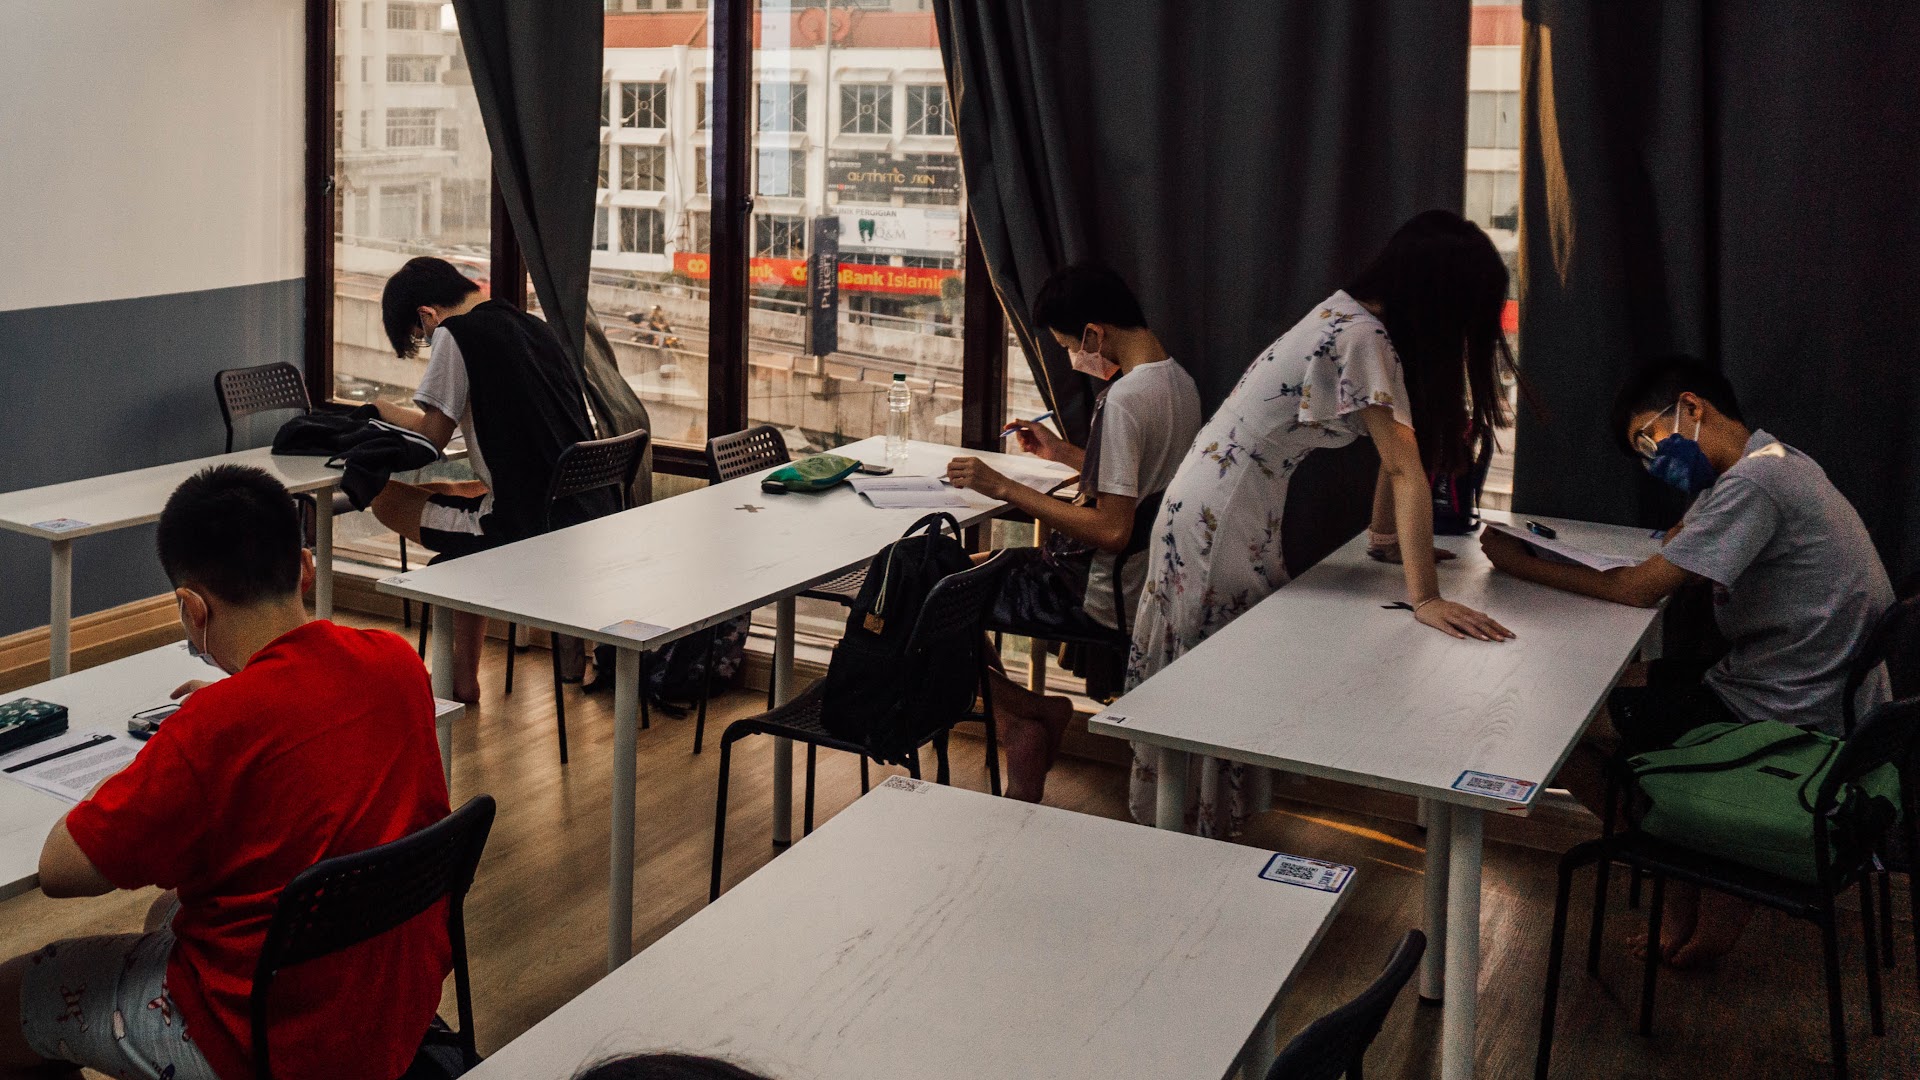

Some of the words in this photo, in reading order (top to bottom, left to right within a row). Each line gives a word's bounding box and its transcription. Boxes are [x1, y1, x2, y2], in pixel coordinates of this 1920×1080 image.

[911, 174, 936, 185] SKIN
[855, 208, 897, 217] PERGIGIAN
[875, 227, 906, 241] Q&M
[838, 269, 884, 286] Bank
